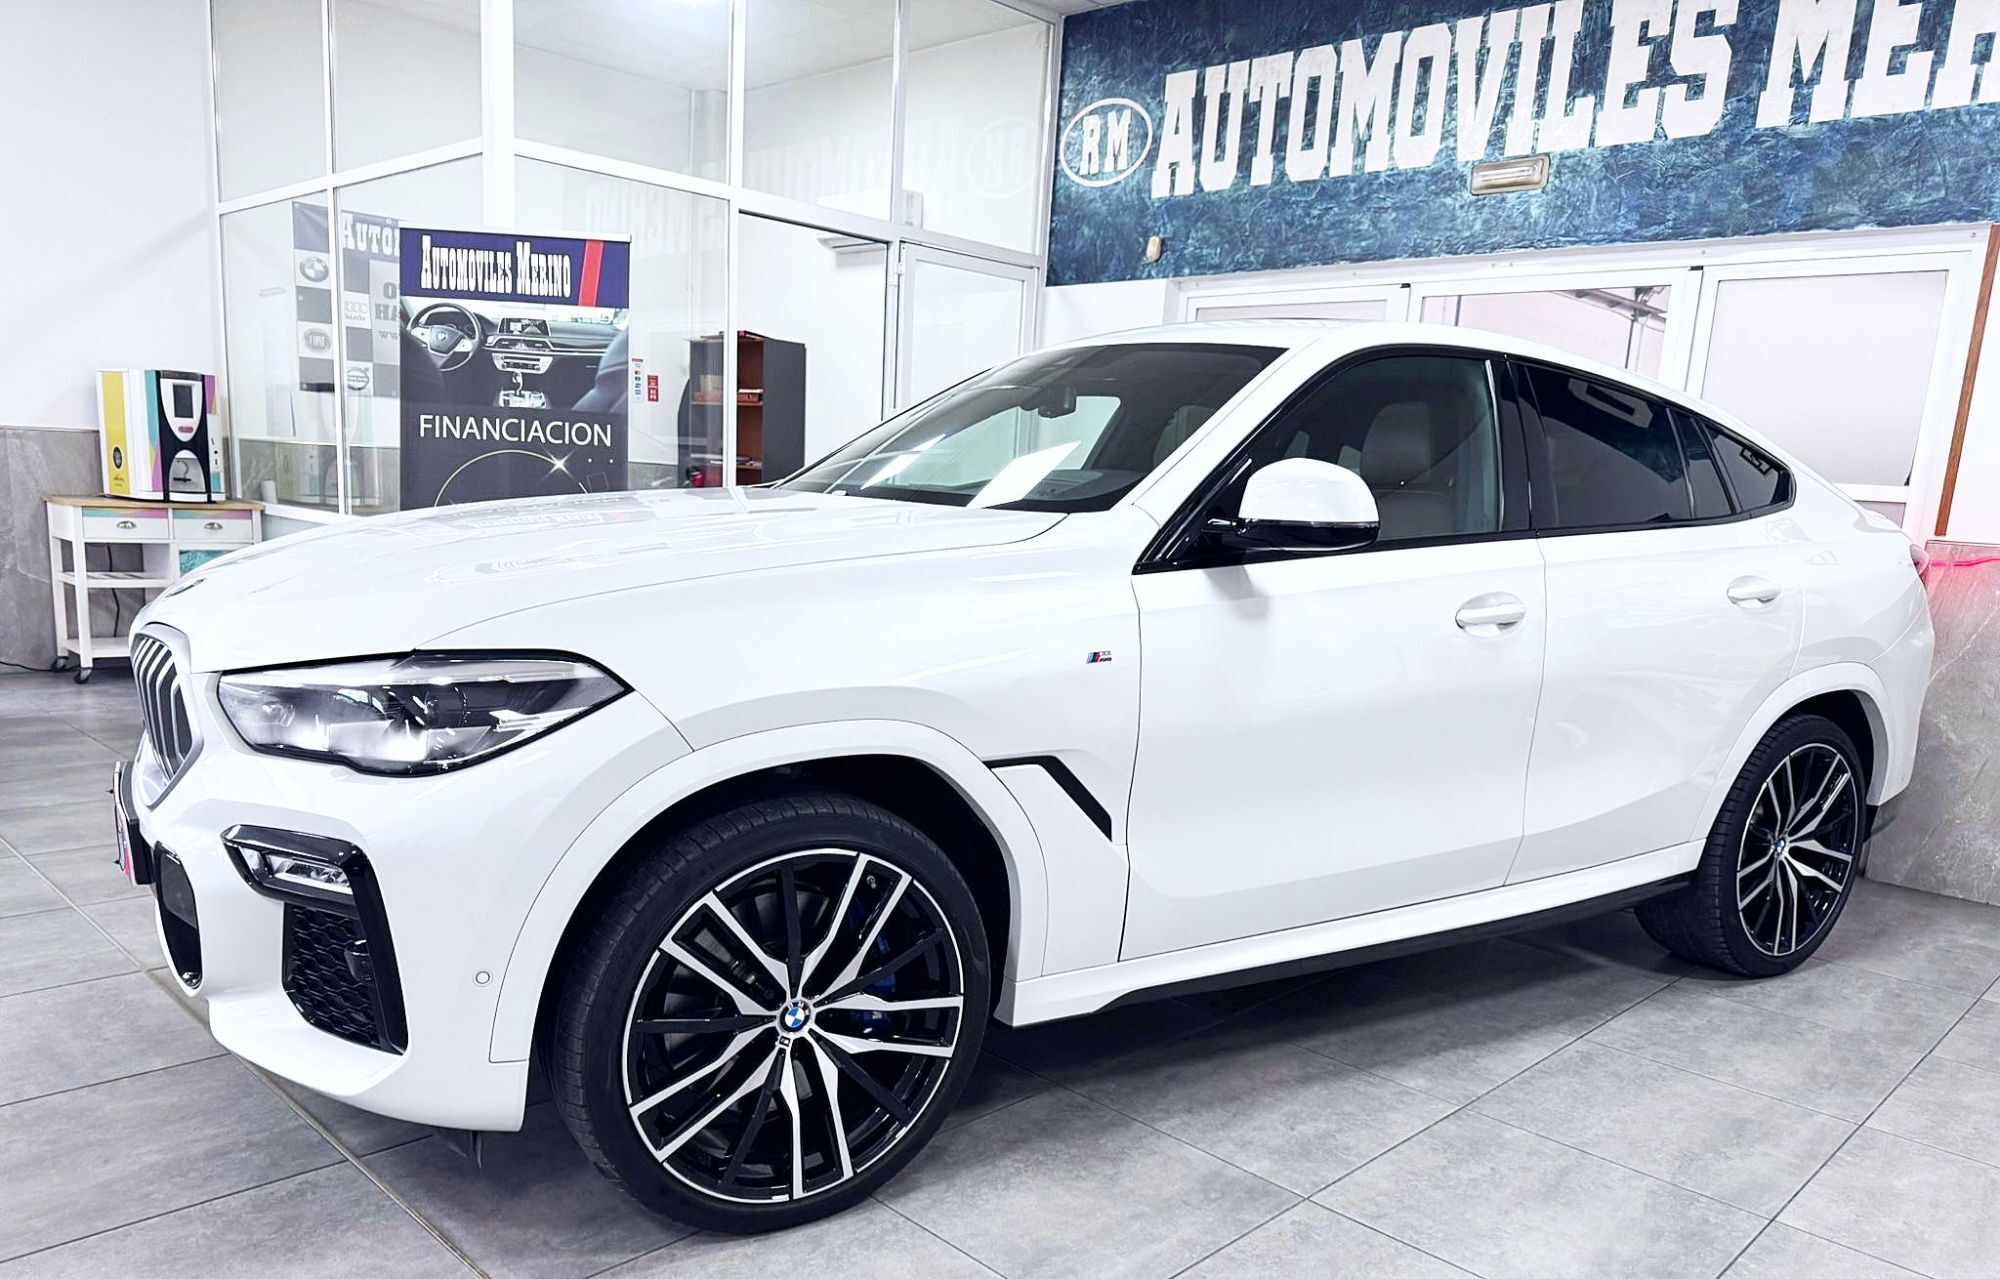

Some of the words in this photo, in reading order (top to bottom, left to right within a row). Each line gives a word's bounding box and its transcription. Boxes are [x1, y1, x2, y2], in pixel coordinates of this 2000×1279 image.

[1151, 0, 1739, 199] AUTOMOVILES
[1080, 109, 1131, 175] RM
[421, 235, 512, 294] AUTOMOVILES
[516, 241, 571, 298] MERINO
[419, 414, 612, 447] FINANCIACION
